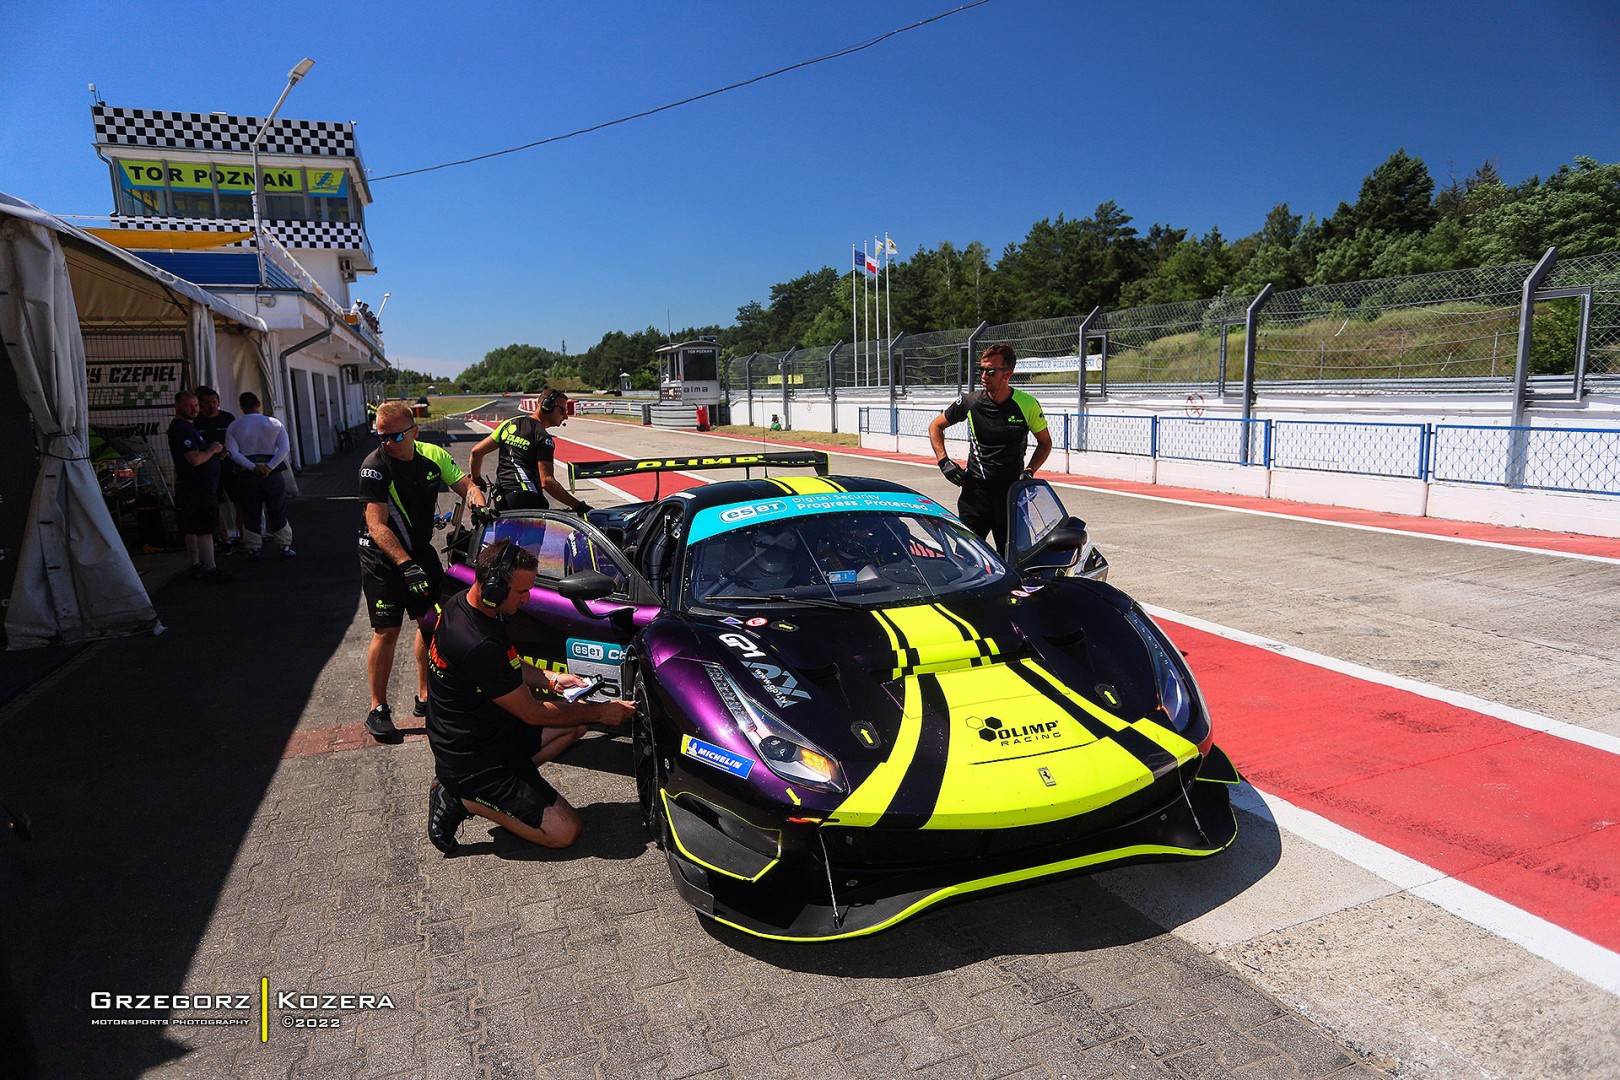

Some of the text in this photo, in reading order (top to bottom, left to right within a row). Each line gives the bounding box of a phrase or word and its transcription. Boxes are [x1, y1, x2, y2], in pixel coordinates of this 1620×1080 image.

[129, 166, 293, 187] TOR POZNAŃ
[109, 366, 177, 383] CZEPIEL
[636, 455, 760, 469] OLIMP
[792, 493, 880, 503] Digital Security
[797, 499, 932, 511] Progress. Protected.
[719, 633, 767, 658] GP1
[998, 721, 1058, 740] OLIMP
[1000, 732, 1062, 746] RACING
[698, 748, 743, 769] MICHELIN
